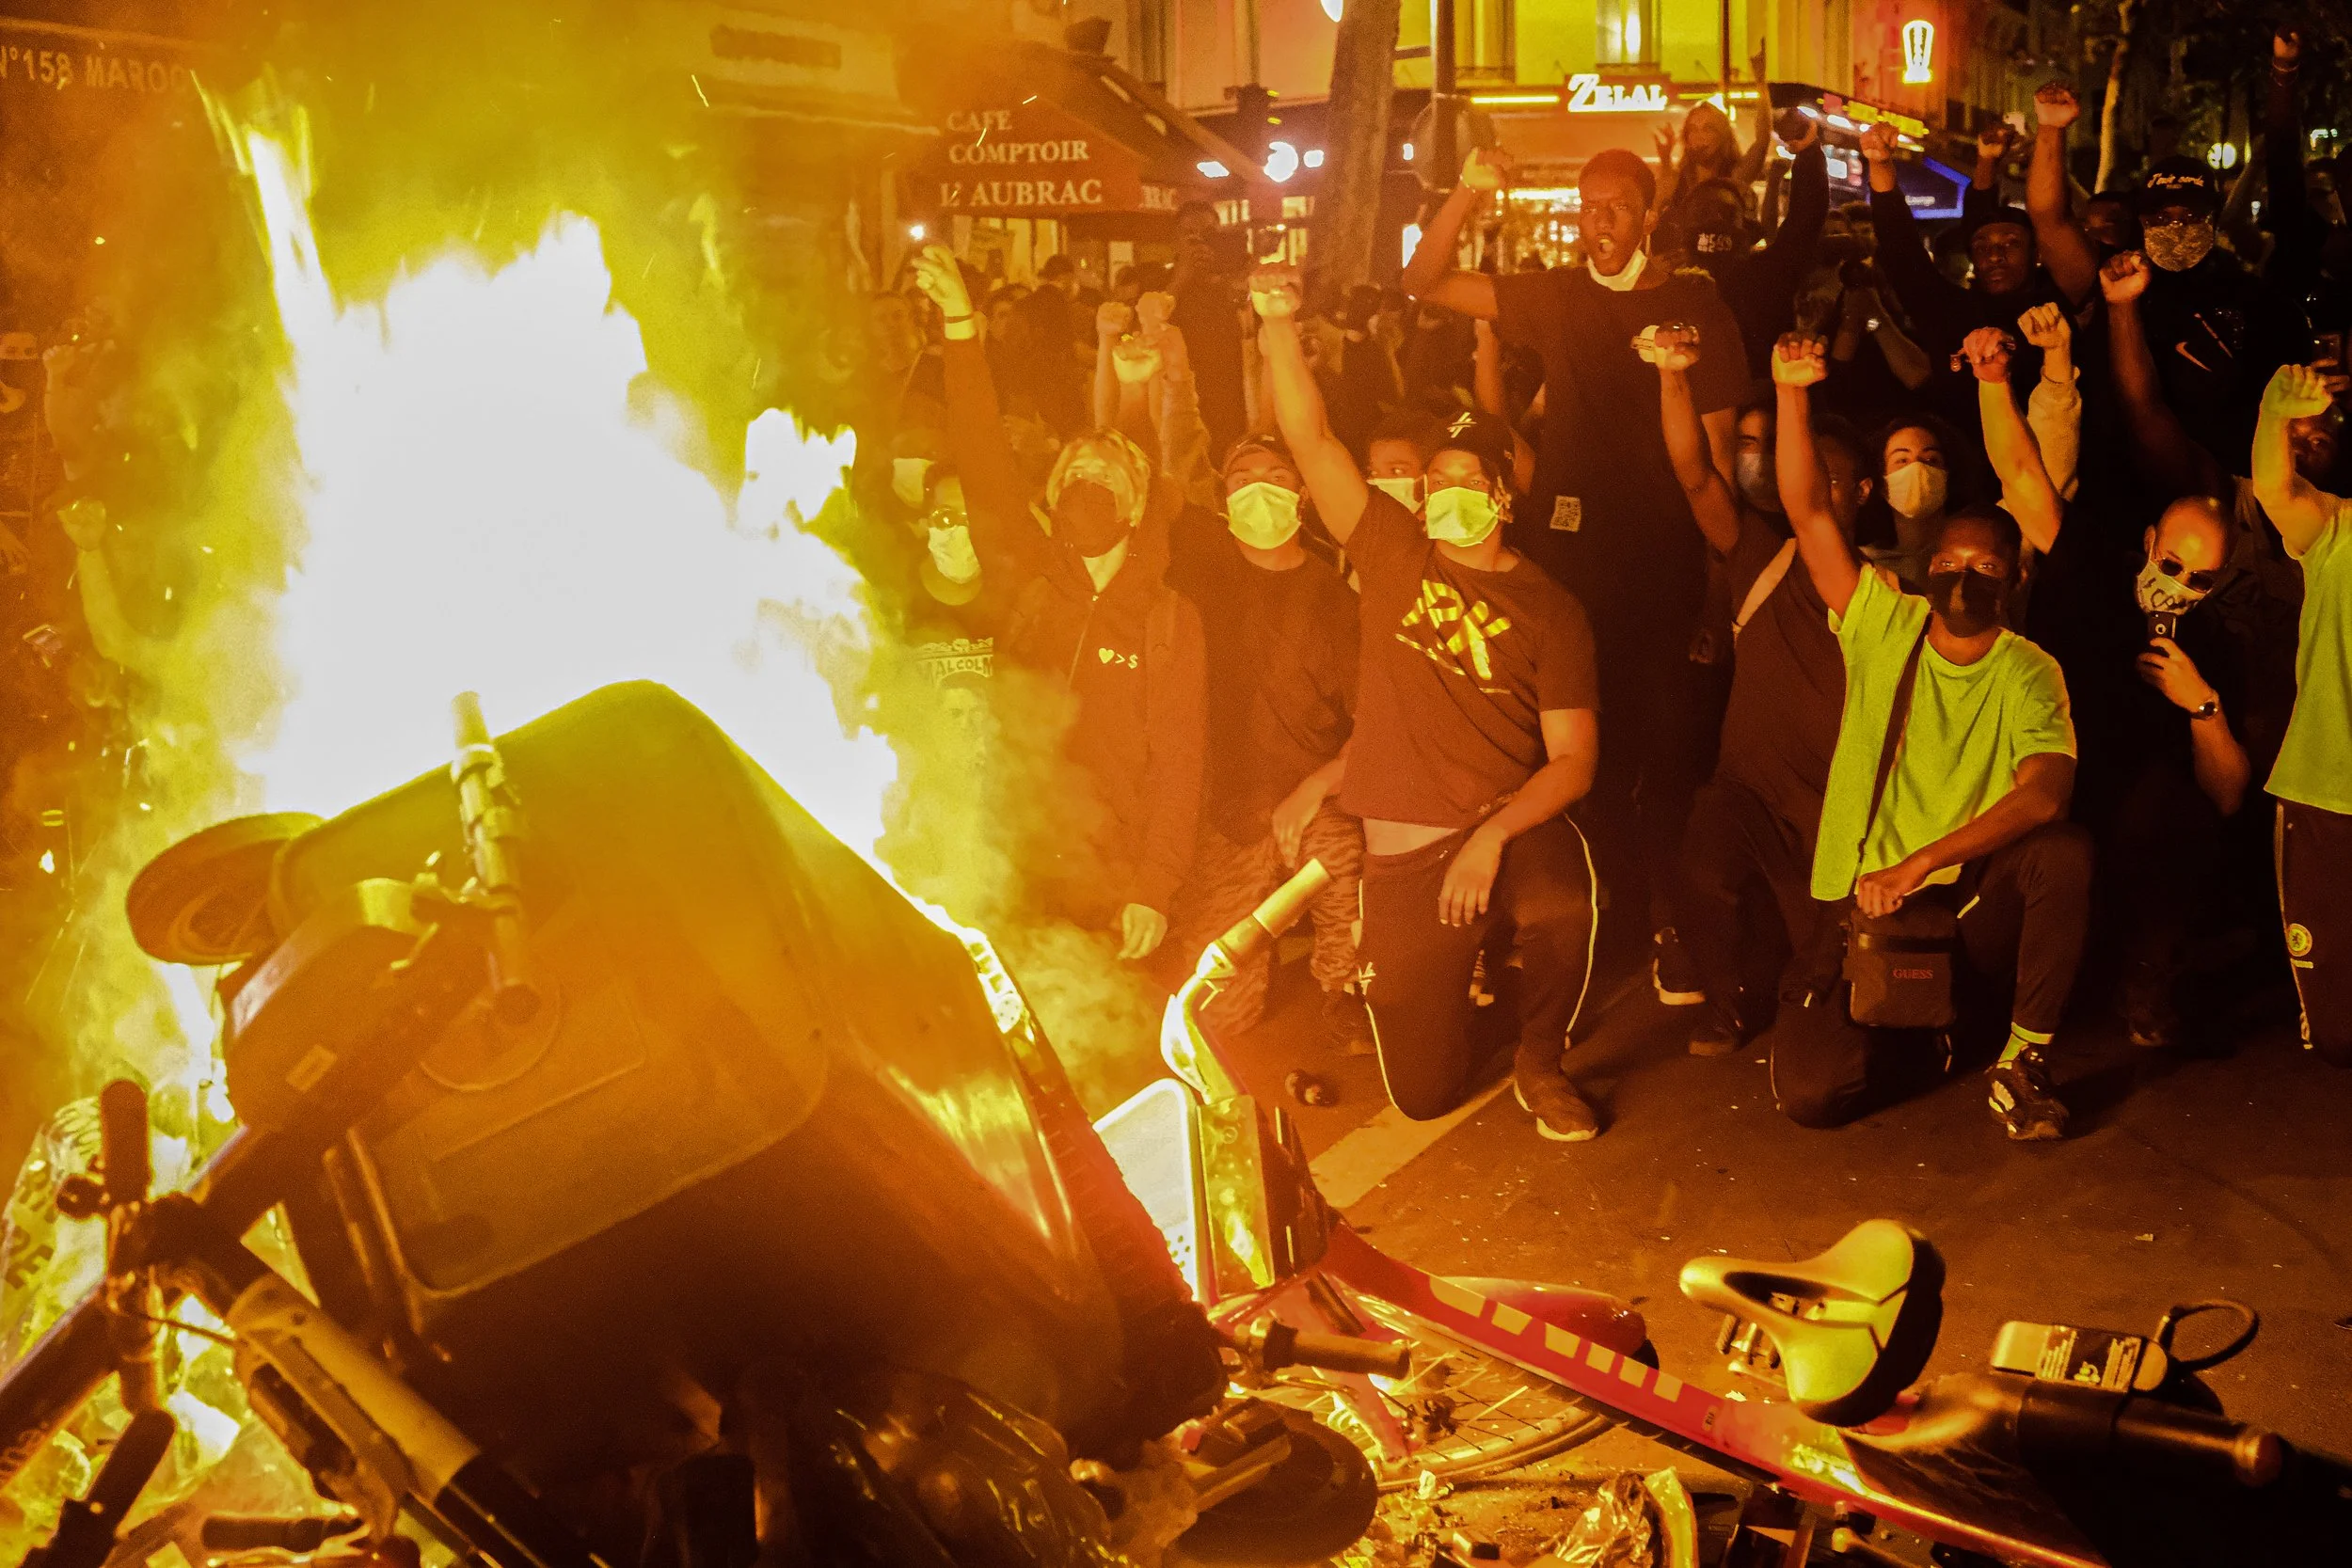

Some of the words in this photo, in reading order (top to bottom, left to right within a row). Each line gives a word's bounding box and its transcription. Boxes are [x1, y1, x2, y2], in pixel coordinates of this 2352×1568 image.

[949, 140, 1089, 164] COMPTOIR
[970, 179, 1103, 205] AUBRAC
[1892, 967, 1934, 979] GUESS
